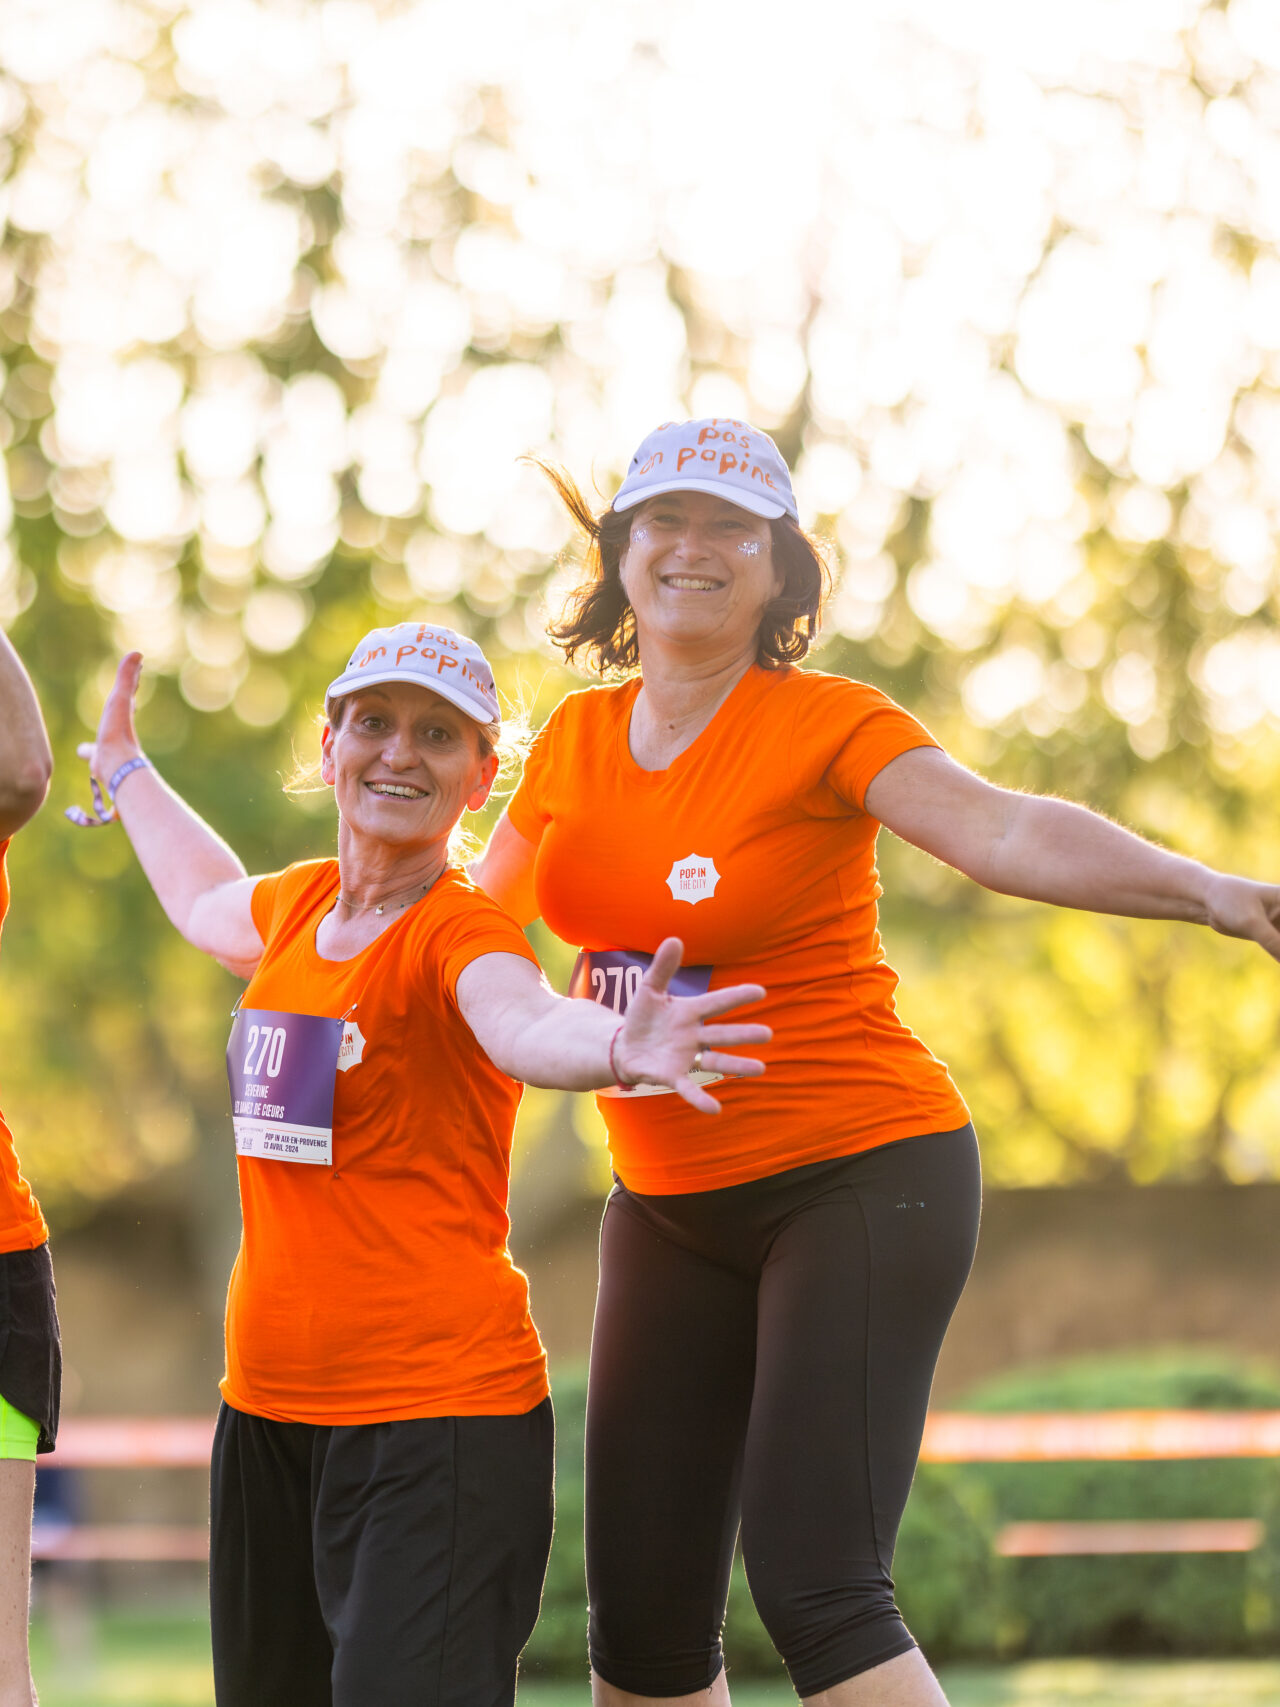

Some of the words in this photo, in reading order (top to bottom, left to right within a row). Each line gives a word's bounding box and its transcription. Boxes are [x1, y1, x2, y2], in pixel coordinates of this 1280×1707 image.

[697, 427, 750, 449] pas
[677, 448, 779, 491] popine
[416, 630, 460, 650] pas
[395, 645, 489, 697] popine
[679, 868, 696, 879] POP
[697, 866, 706, 877] IN
[680, 879, 691, 890] THE
[692, 878, 706, 889] CITY
[345, 1033, 353, 1045] IN
[243, 1025, 287, 1078] 270
[341, 1045, 354, 1057] CITY
[265, 1132, 274, 1141] POP
[274, 1133, 280, 1142] IN
[269, 1142, 283, 1151] AVRIL
[285, 1144, 299, 1153] 2024
